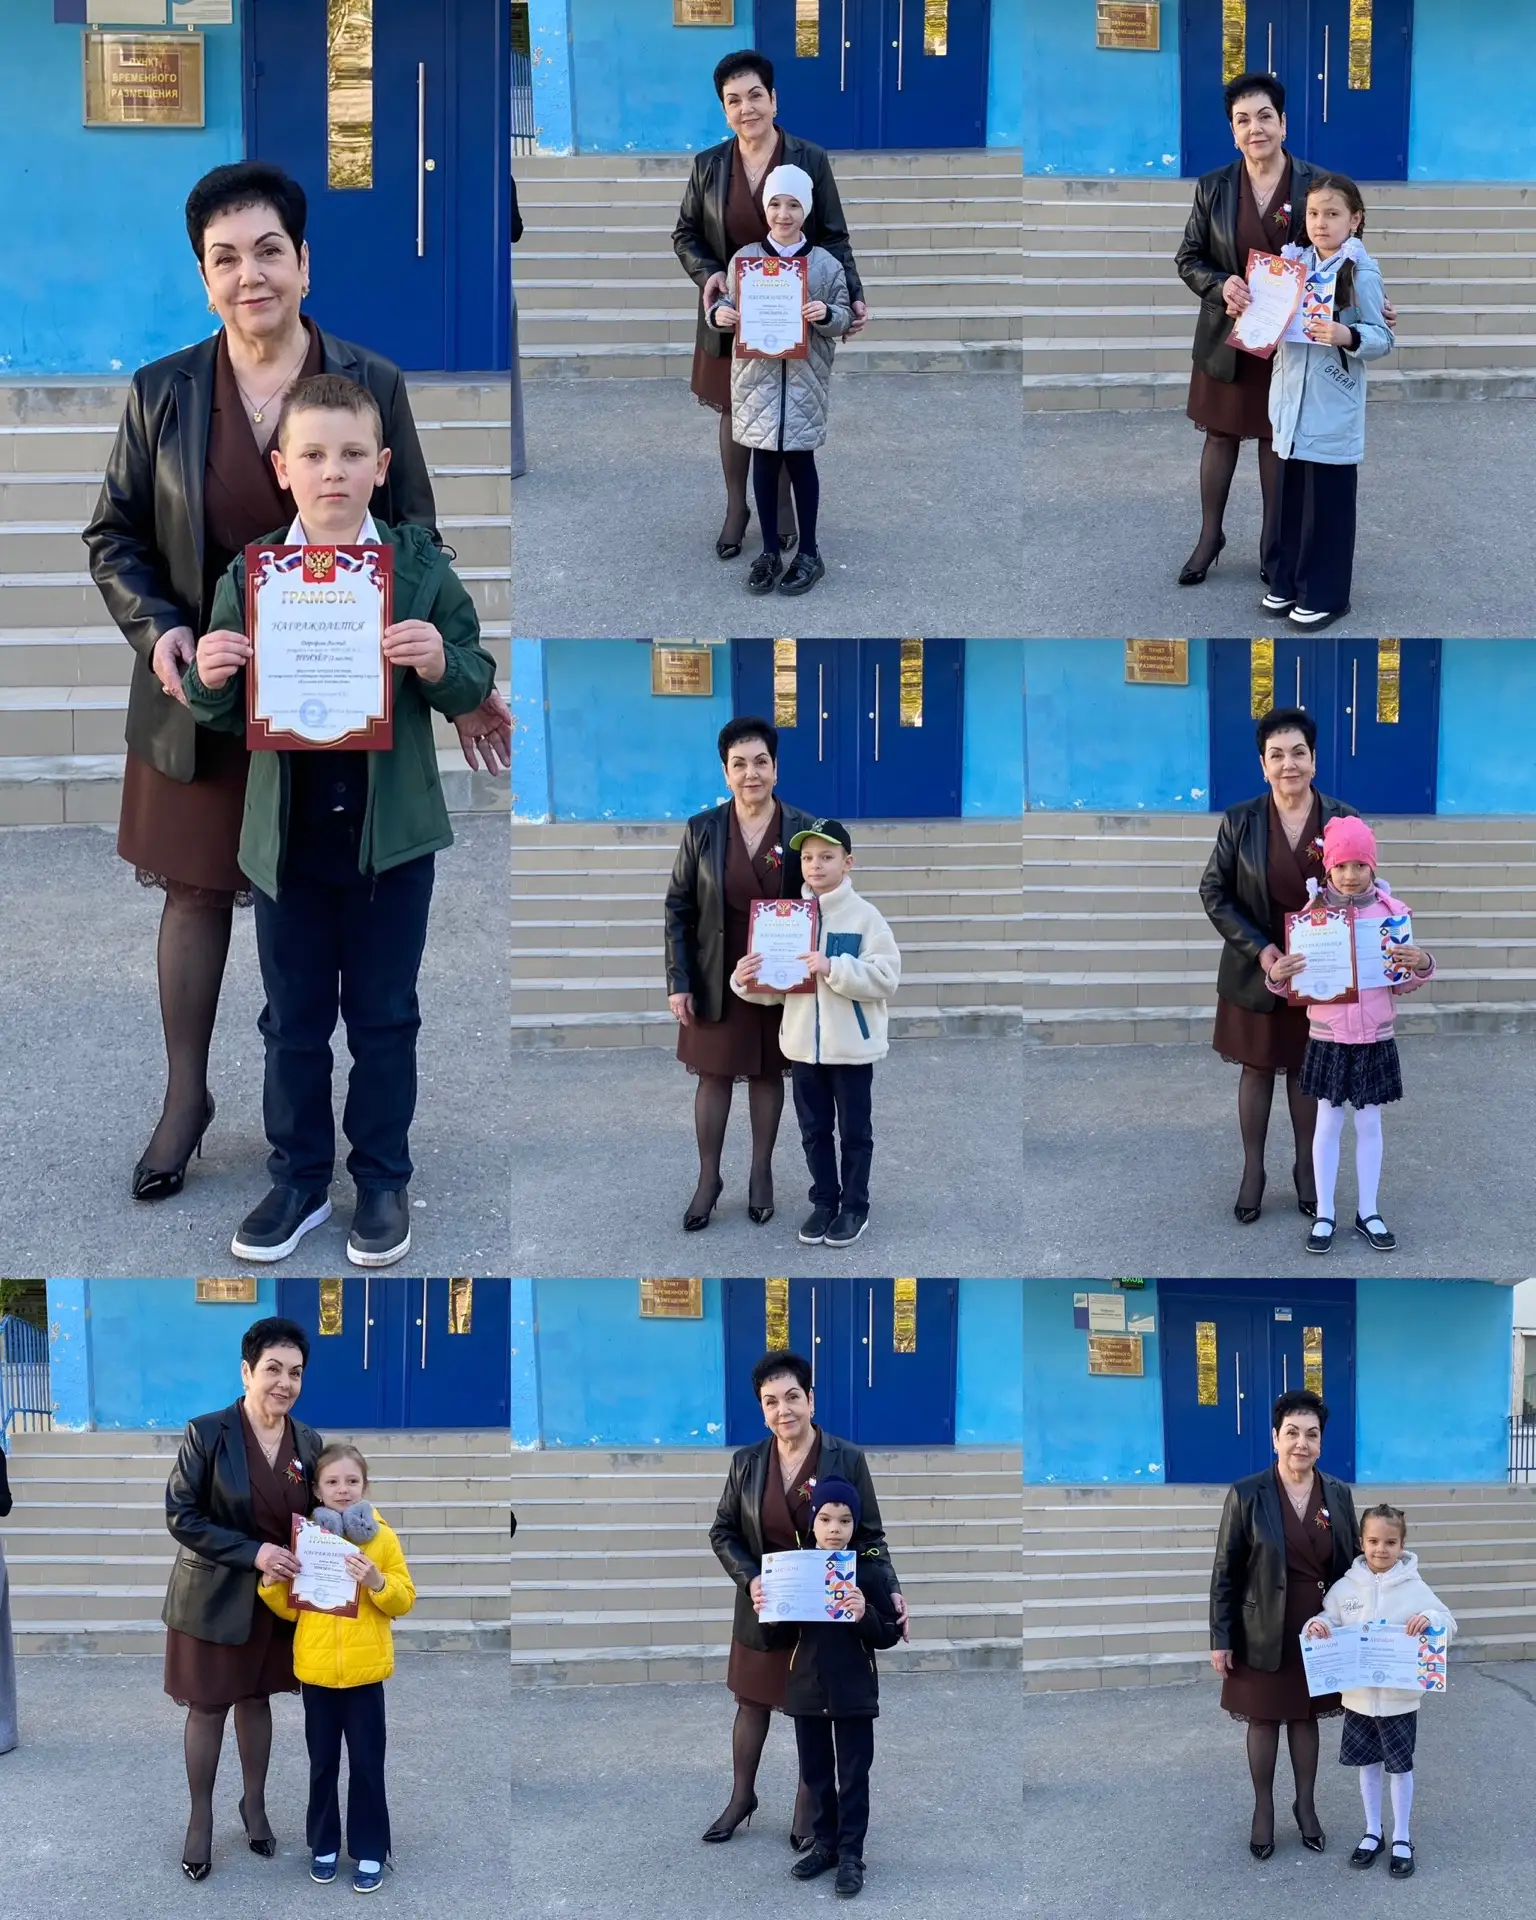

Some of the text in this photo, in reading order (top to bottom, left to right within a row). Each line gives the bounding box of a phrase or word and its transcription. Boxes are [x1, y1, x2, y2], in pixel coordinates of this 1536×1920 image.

[129, 57, 159, 68] ПУНКТ
[111, 73, 178, 83] ВРЕМЕННОГО
[111, 88, 179, 98] РАЗМЕЩЕНИЯ
[1324, 364, 1356, 390] GREAM
[281, 590, 357, 605] ГРАМОТА
[271, 620, 366, 632] НАГРАЖДАЕТСЯ
